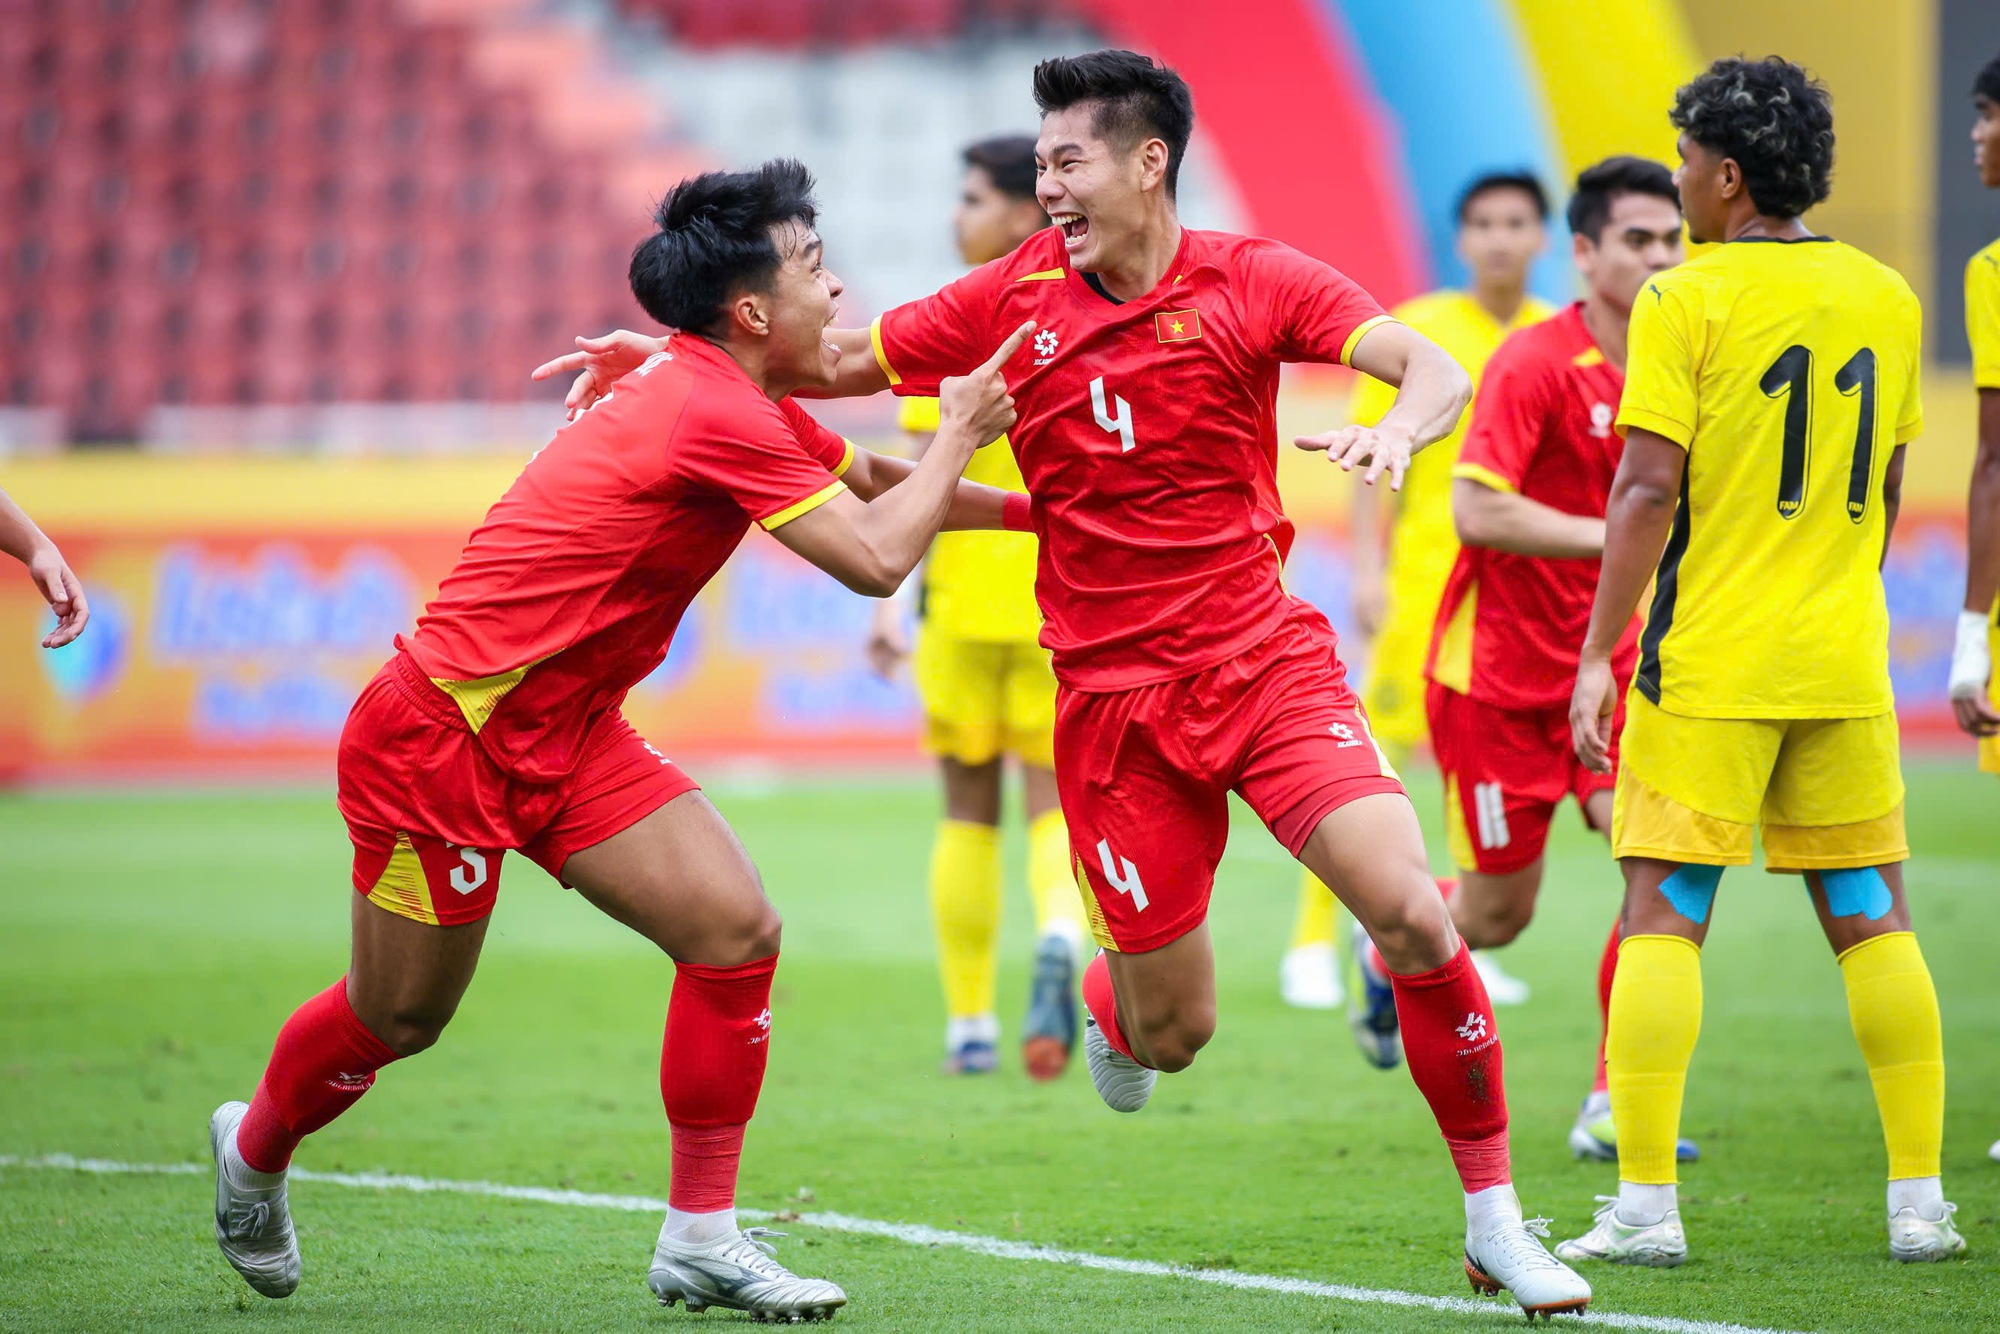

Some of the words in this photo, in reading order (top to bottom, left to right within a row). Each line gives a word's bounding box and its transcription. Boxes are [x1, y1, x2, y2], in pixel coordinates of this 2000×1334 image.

[1089, 376, 1136, 453] 4
[1759, 344, 1879, 524] 11
[445, 841, 487, 895] 3
[1096, 837, 1150, 913] 4
